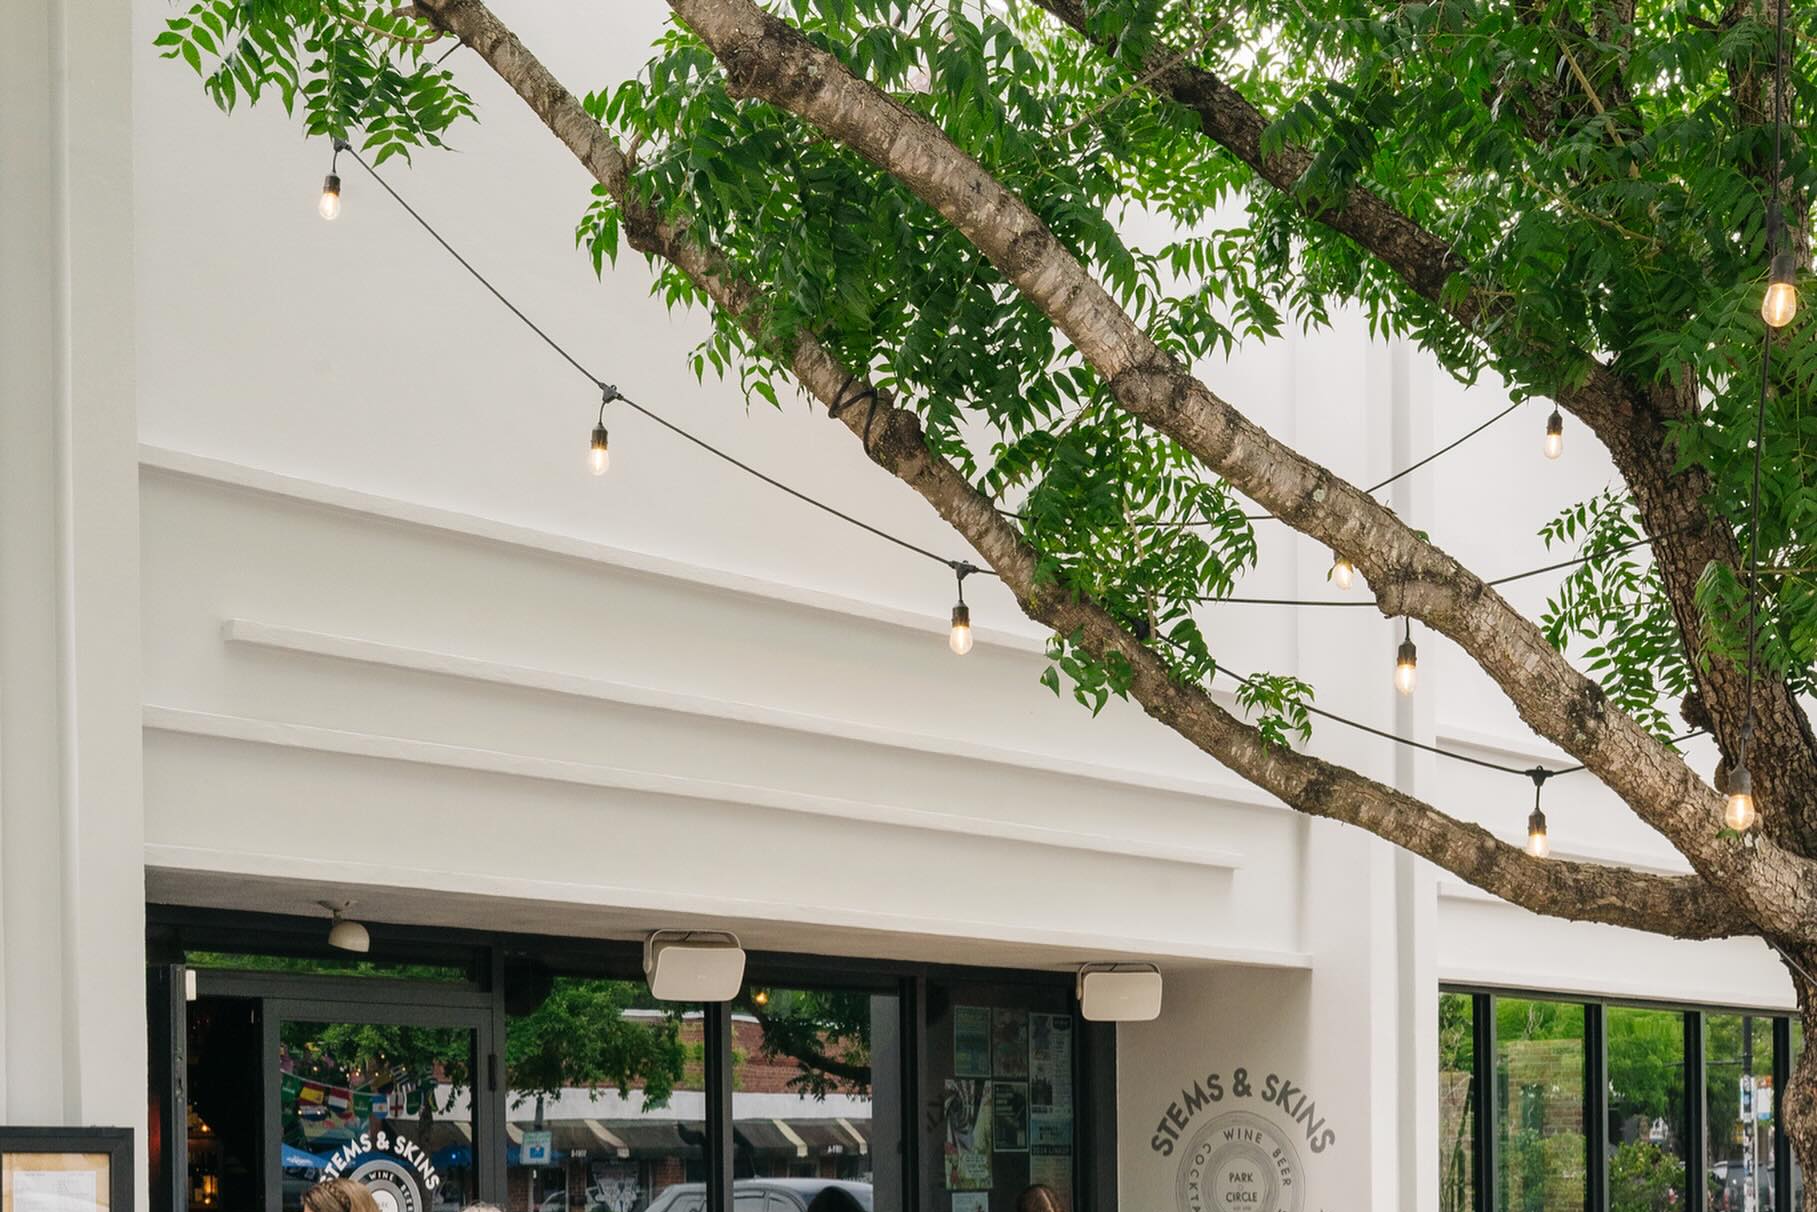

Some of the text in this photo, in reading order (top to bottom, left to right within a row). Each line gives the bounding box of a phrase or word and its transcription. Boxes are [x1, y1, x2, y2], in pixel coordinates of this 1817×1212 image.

[1151, 1068, 1336, 1157] STEMS & SKINS
[1223, 1128, 1263, 1144] WINE
[376, 1131, 390, 1150] &
[394, 1135, 440, 1190] SKINS
[1272, 1148, 1292, 1187] BEER
[369, 1171, 394, 1181] WINE
[1229, 1172, 1254, 1183] PARK
[1225, 1192, 1258, 1203] CIRCLE
